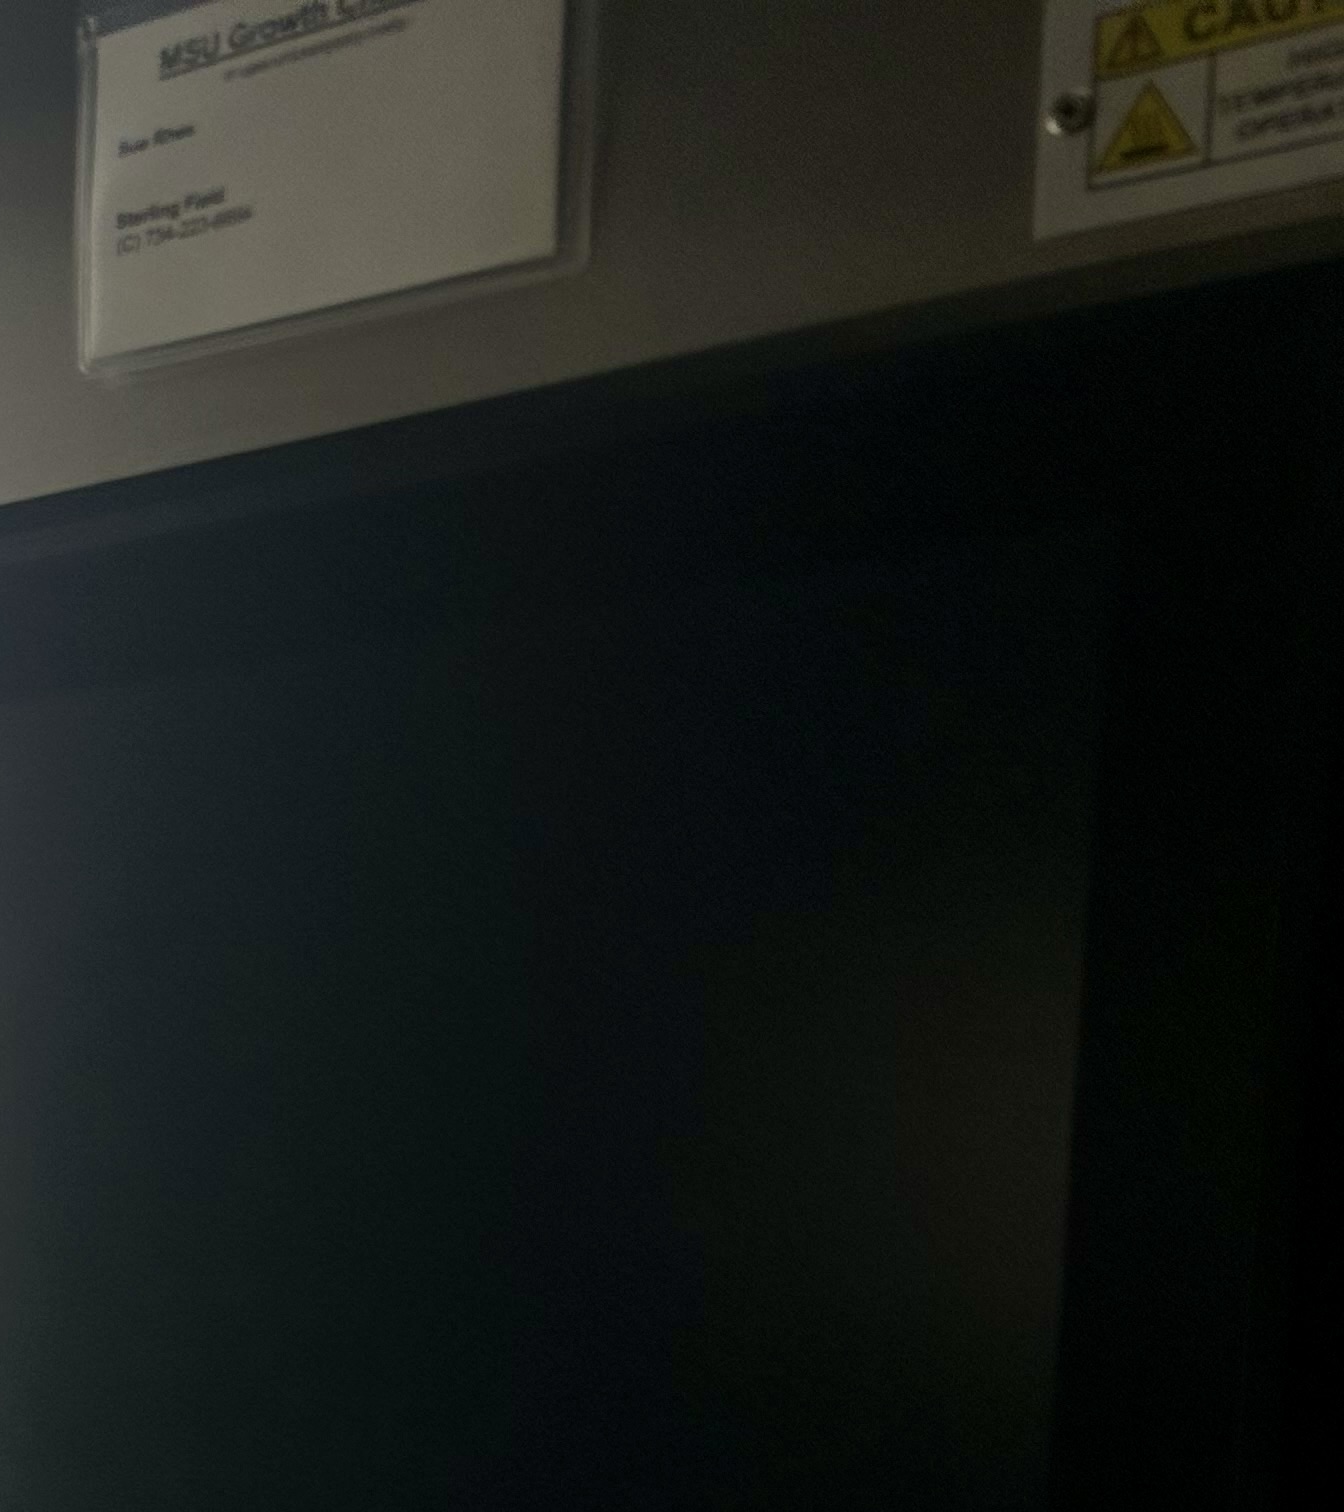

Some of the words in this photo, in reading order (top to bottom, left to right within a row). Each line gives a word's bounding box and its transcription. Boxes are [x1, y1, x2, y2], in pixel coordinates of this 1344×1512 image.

[159, 31, 221, 71] MSU
[229, 1, 329, 50] Growth
[116, 202, 180, 229] Sterling
